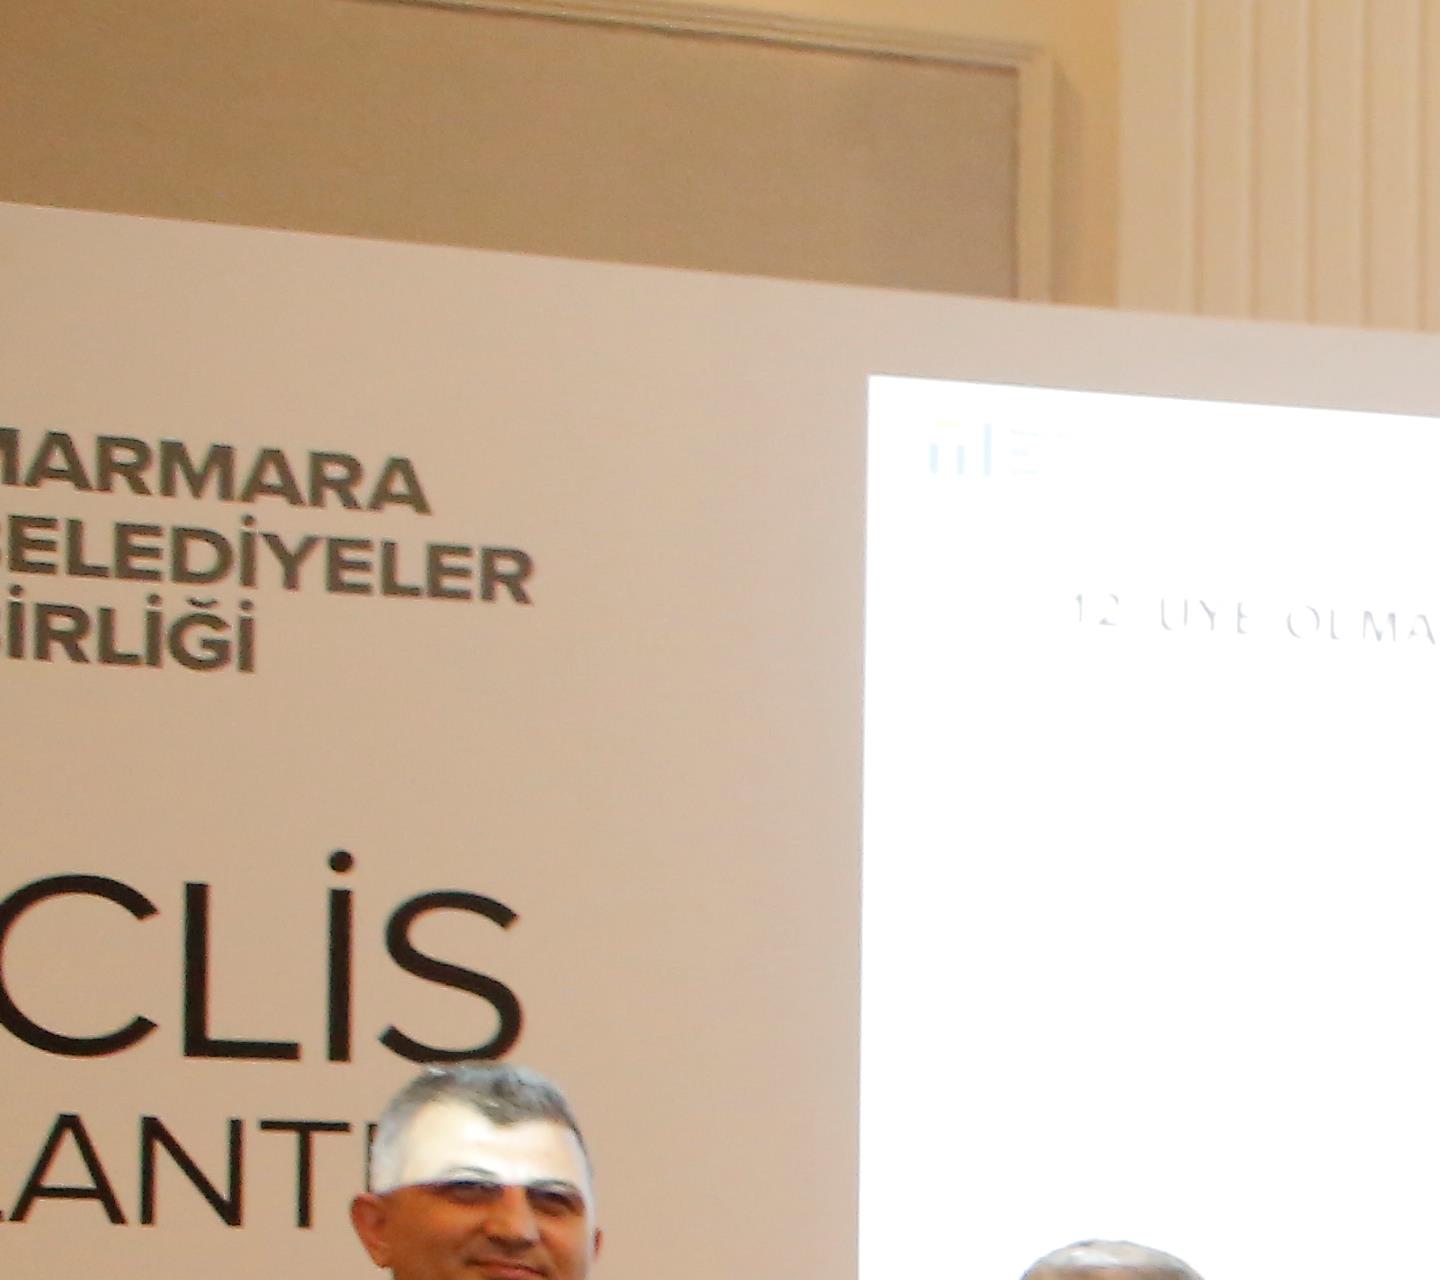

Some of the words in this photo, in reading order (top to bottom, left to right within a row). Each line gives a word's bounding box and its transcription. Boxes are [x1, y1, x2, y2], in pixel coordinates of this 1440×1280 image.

[0, 427, 430, 515] ARMARA
[0, 514, 535, 605] ELEDİYELER
[0, 584, 257, 673] İRLİĞİ
[0, 848, 524, 1064] CLİS
